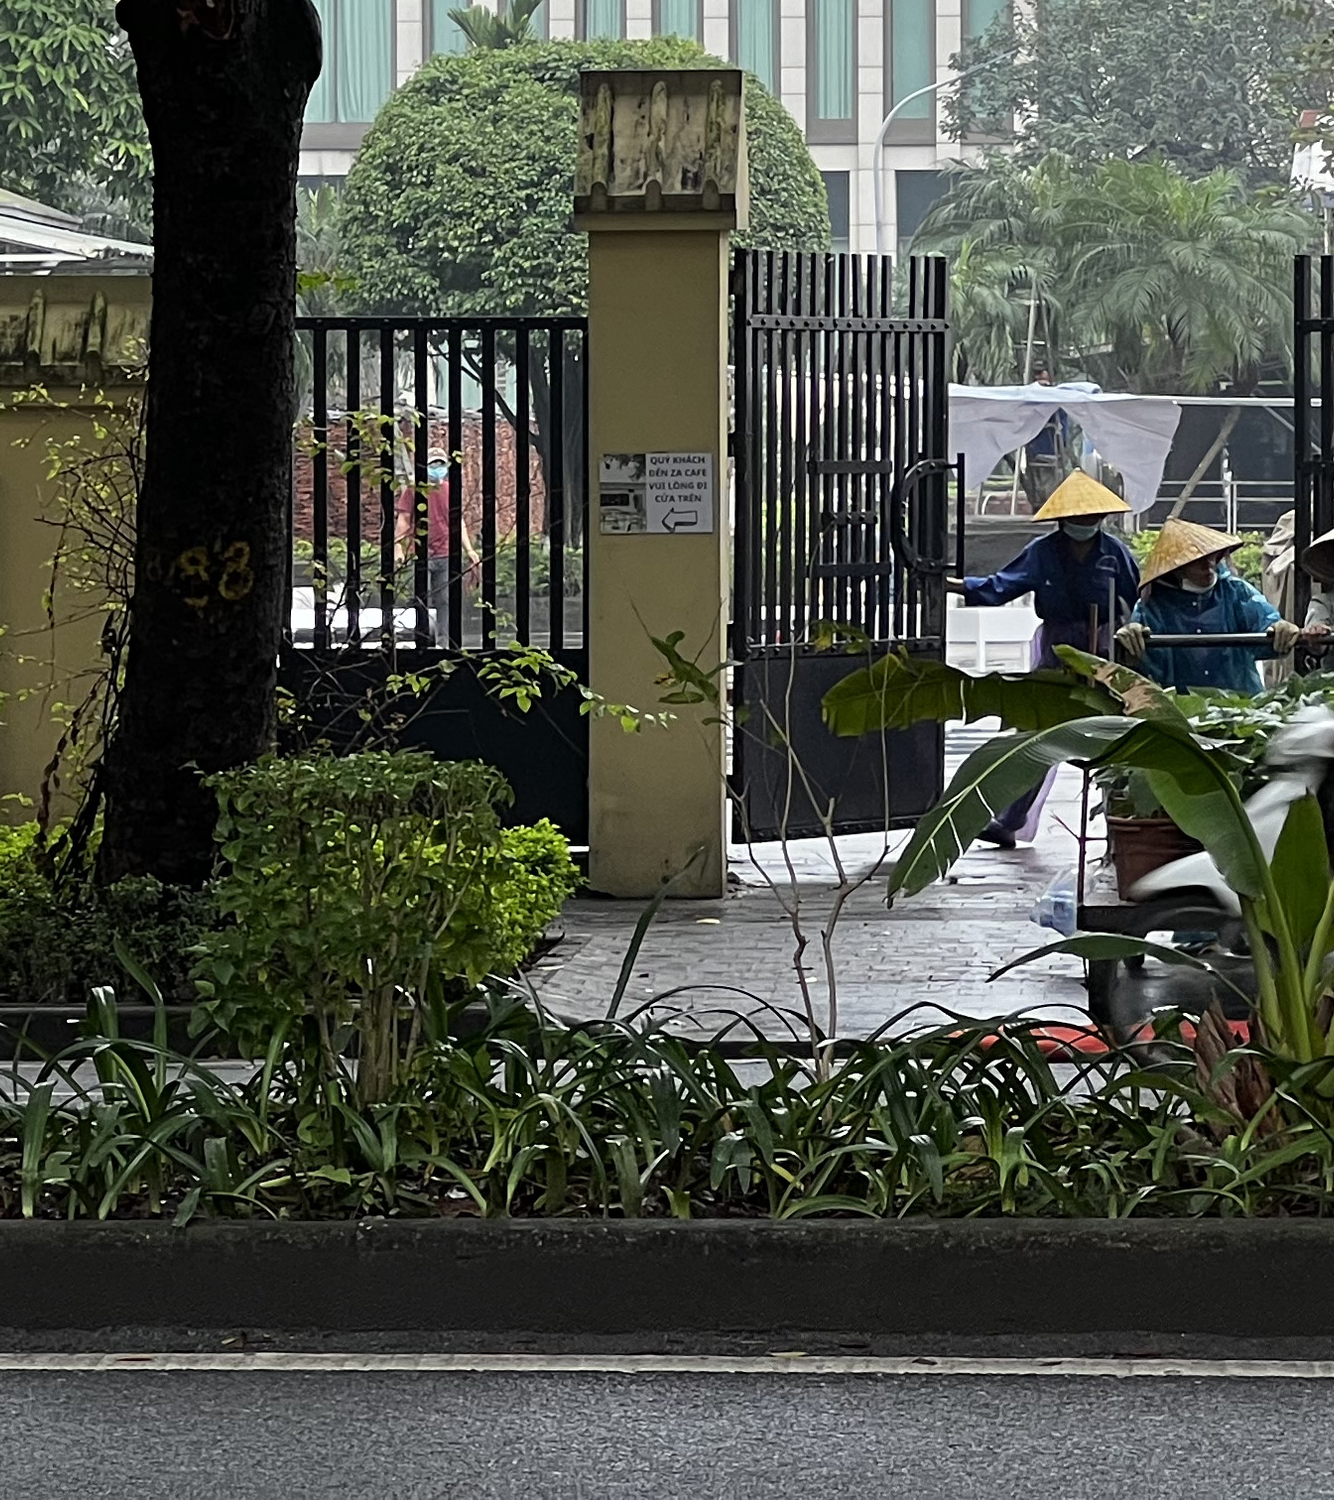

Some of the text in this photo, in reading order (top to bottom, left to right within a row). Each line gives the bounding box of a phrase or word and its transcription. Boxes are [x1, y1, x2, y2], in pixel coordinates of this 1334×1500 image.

[670, 469, 683, 477] ZA
[684, 469, 707, 477] CAFE
[649, 482, 665, 490] VUI
